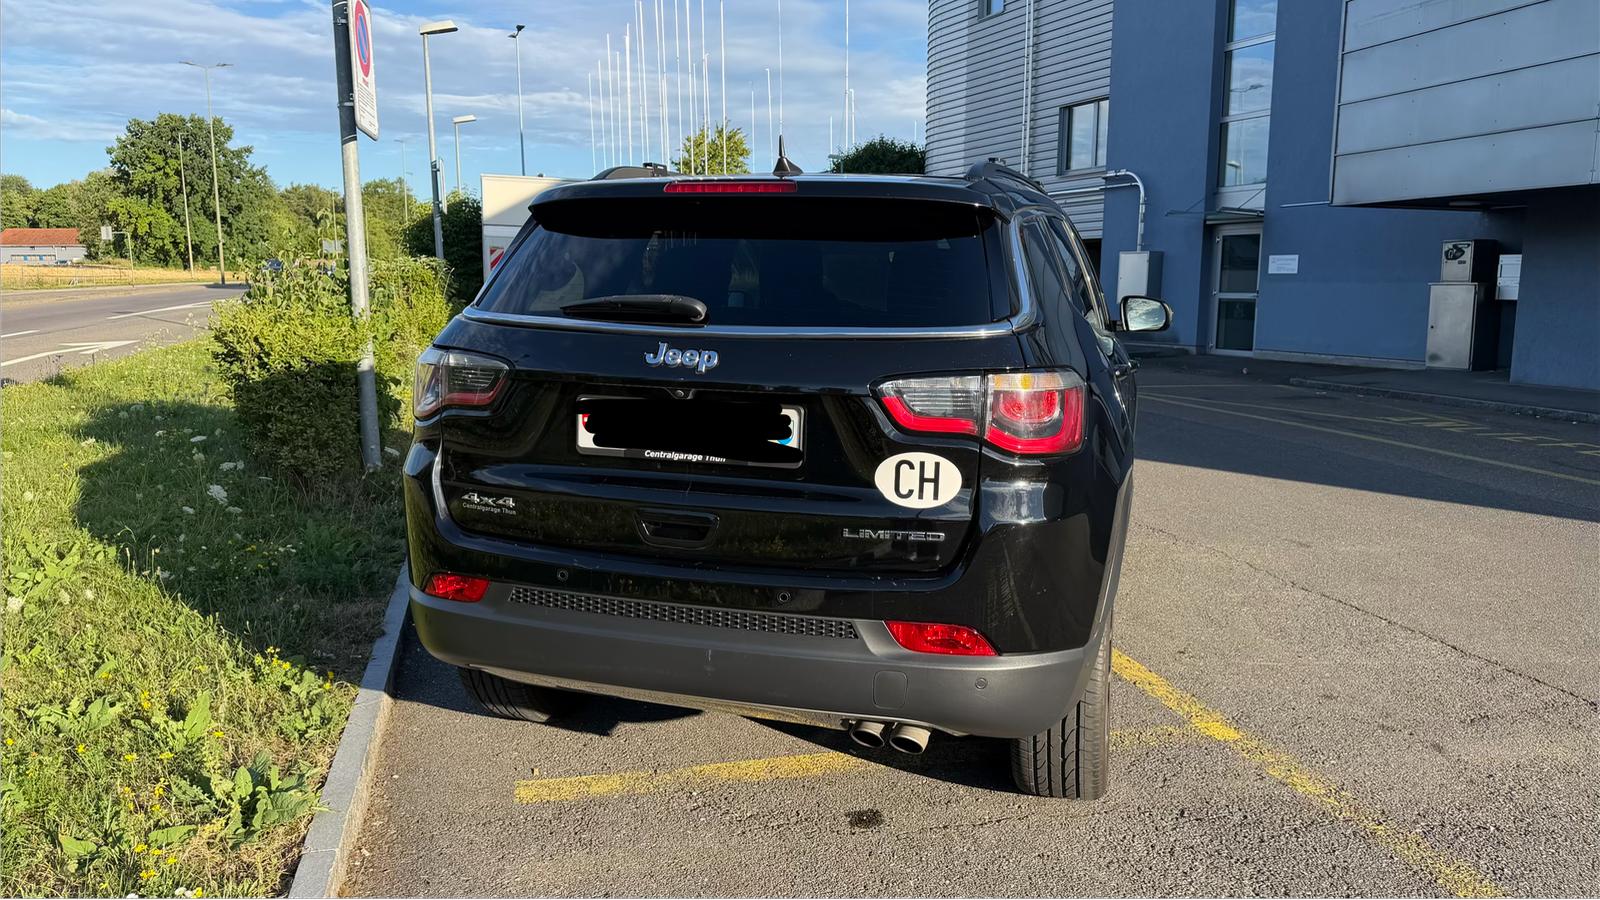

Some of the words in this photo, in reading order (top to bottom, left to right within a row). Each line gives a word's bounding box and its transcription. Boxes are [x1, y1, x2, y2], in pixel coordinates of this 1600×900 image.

[645, 341, 718, 374] Jeep
[644, 449, 703, 462] Centralgarage
[894, 459, 941, 501] CH
[462, 502, 501, 513] Centralgarage
[502, 507, 517, 515] Thun
[842, 527, 946, 542] LIMITED
